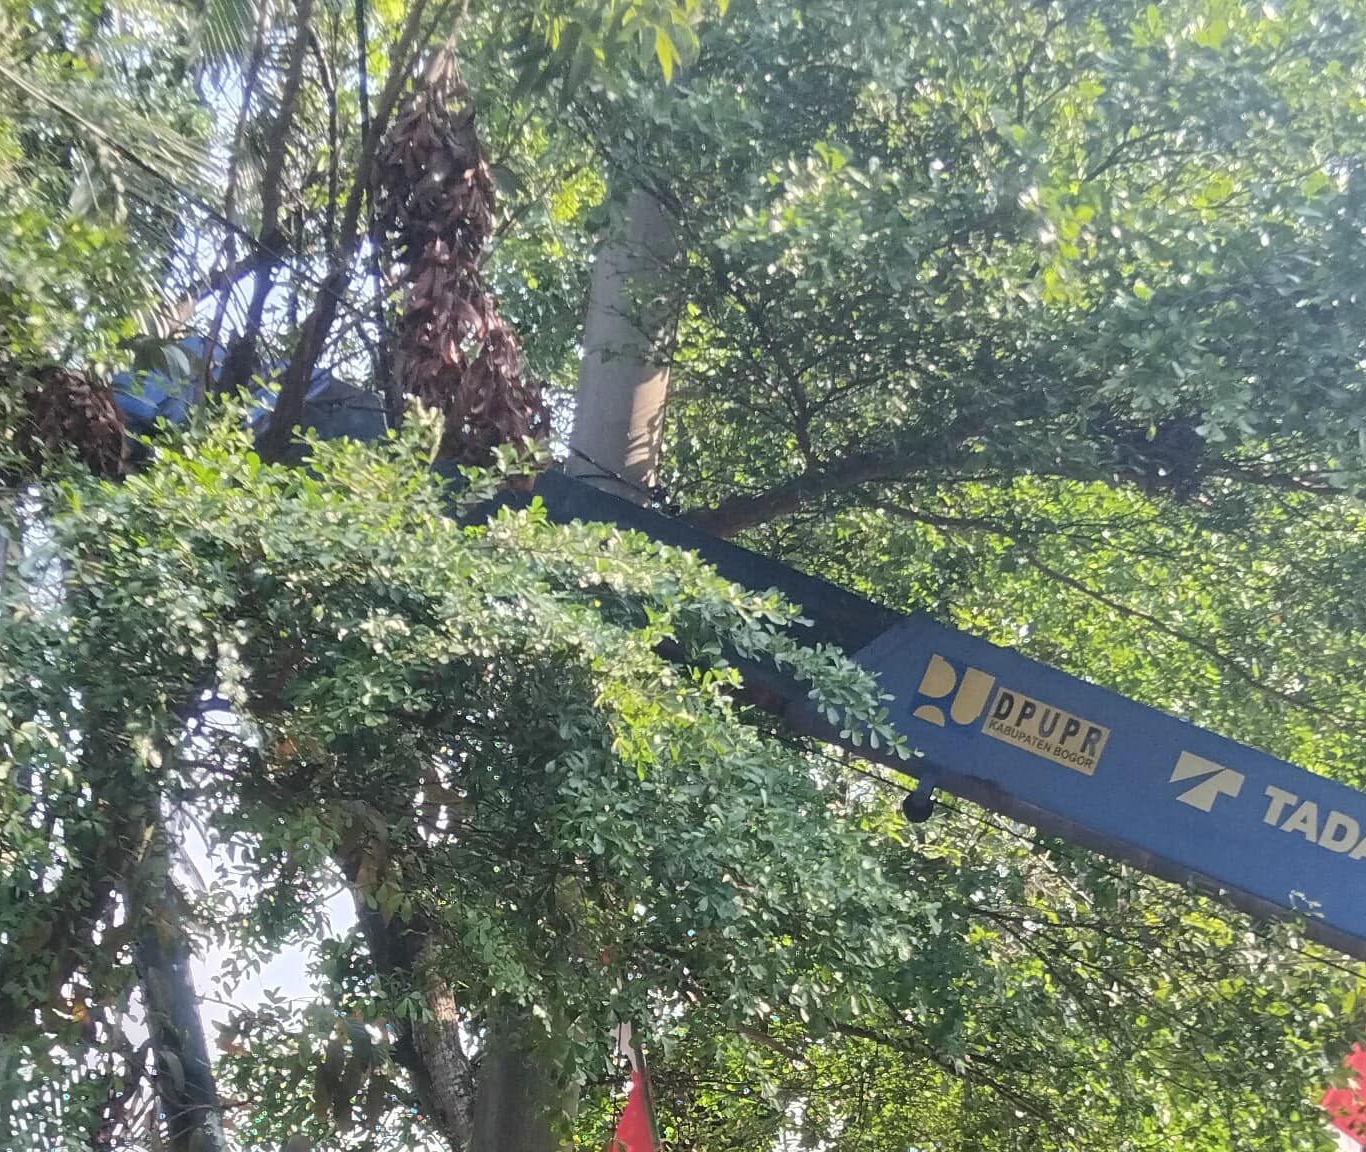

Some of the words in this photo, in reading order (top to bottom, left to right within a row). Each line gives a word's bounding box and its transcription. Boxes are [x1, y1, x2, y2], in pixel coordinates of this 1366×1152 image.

[988, 719, 1053, 752] KABUPATEN
[1053, 746, 1094, 769] BOGOR
[993, 691, 1103, 757] DPUPR
